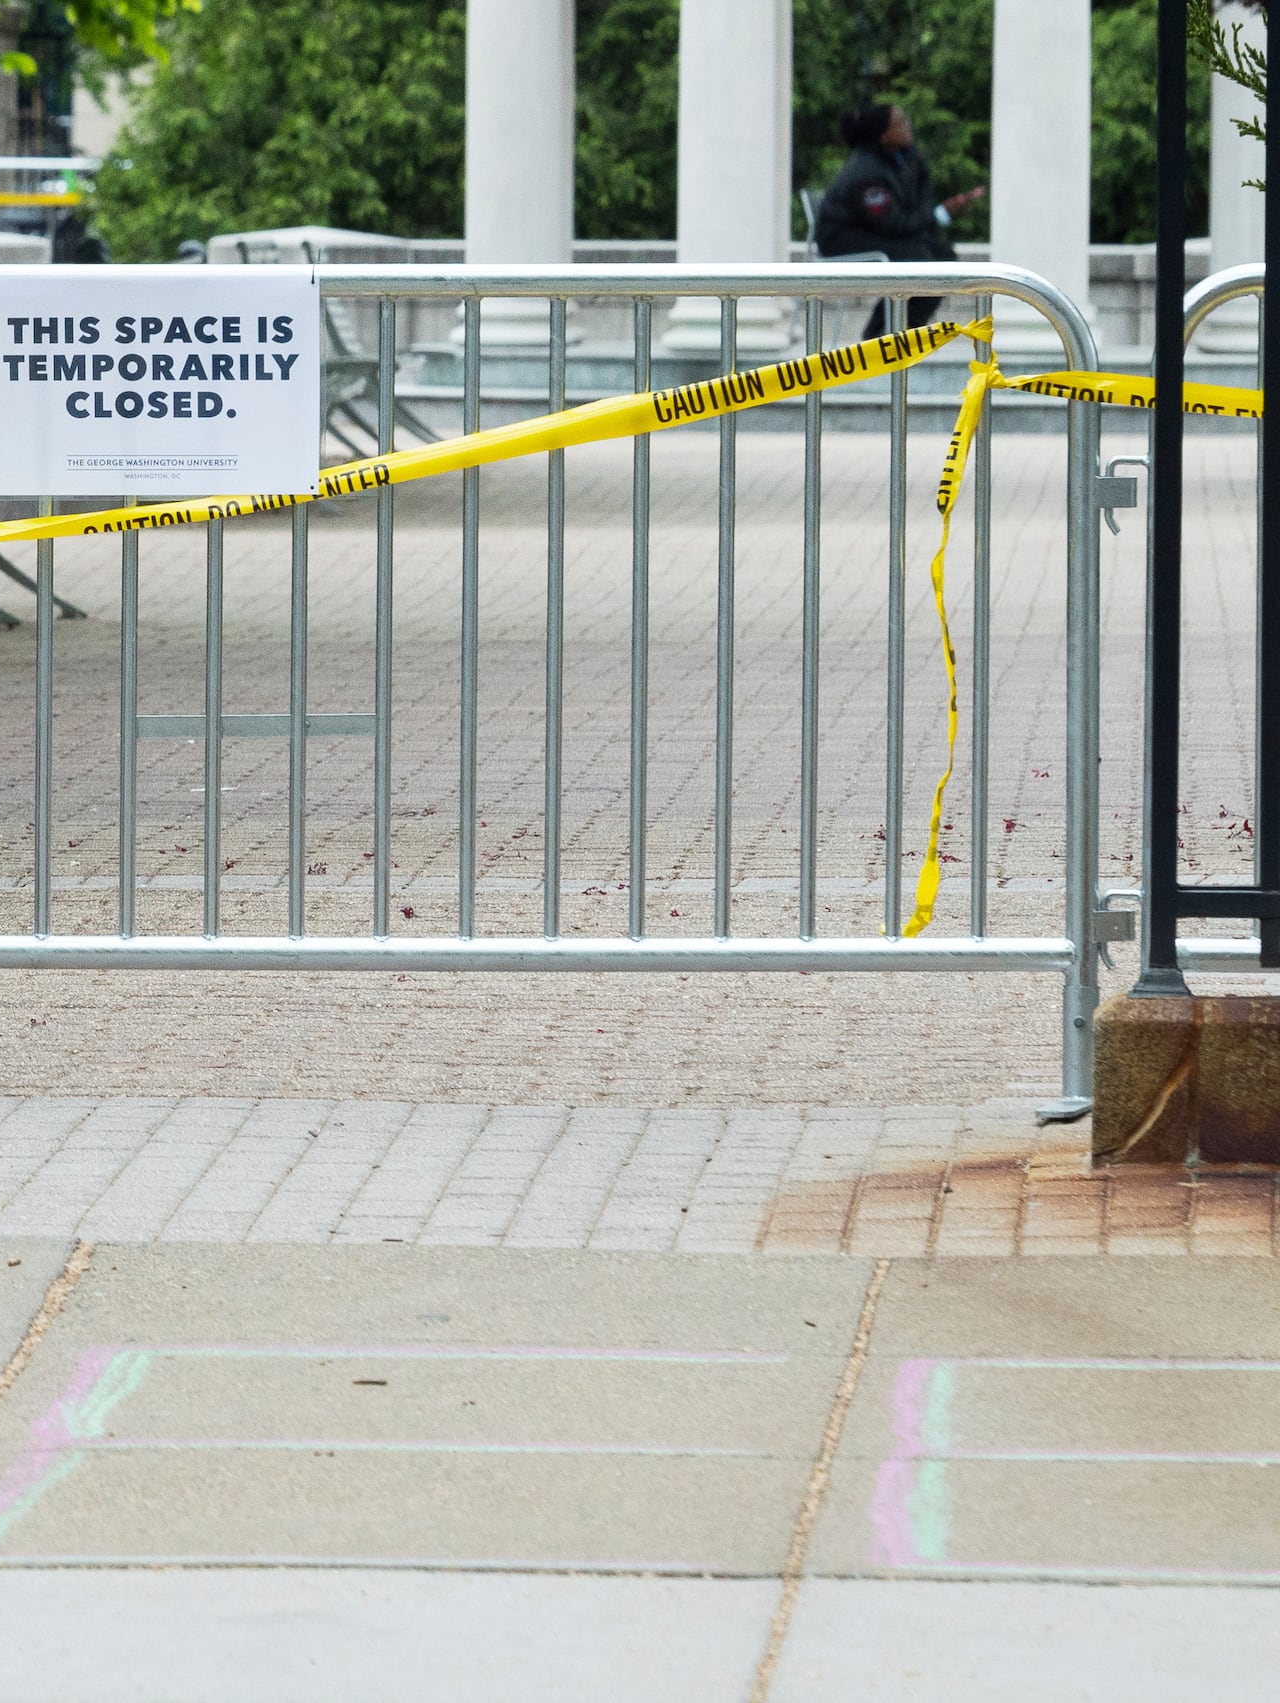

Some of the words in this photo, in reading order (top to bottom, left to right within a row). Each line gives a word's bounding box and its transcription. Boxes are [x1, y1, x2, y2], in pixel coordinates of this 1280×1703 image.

[7, 316, 100, 344] THIS
[115, 316, 241, 344] SPACE
[257, 316, 294, 344] IS
[3, 353, 300, 381] TEMPORARILY
[653, 370, 765, 423] CAUTION
[776, 358, 813, 392] DO
[65, 391, 238, 419] CLOSED.
[313, 463, 390, 499] NTER
